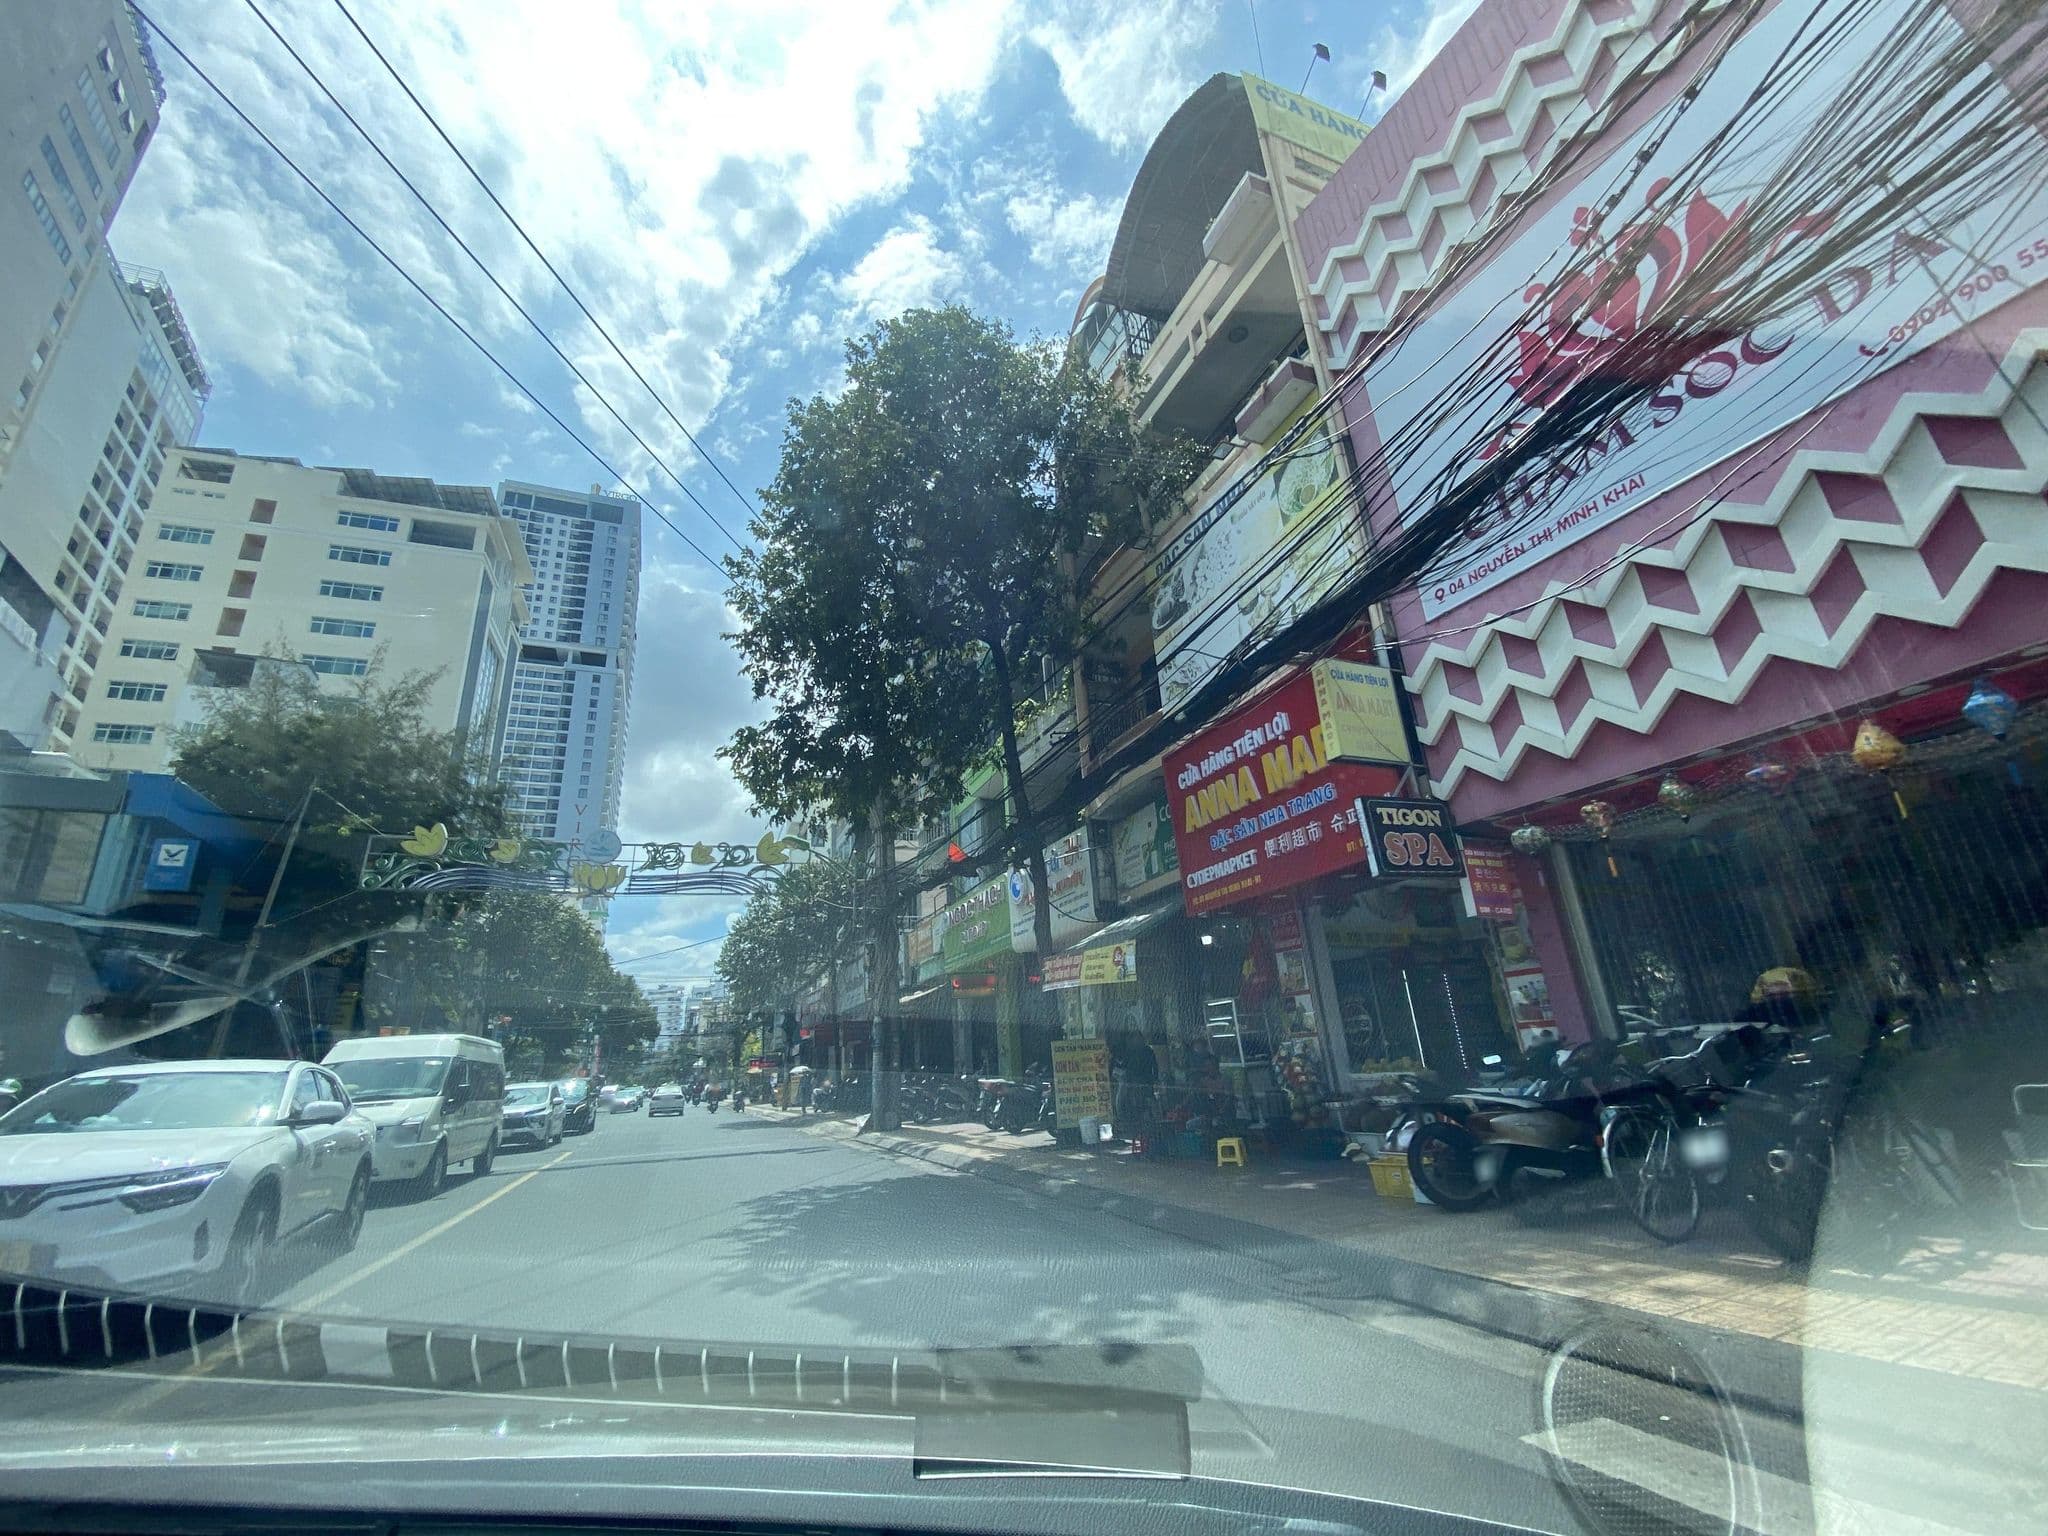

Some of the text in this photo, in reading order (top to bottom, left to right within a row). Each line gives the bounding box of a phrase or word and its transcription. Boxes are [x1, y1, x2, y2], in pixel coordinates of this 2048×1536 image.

[1957, 264, 2010, 301] 900
[1449, 473, 1646, 595] 04 NGUYỄN THỊ MINH KHAI
[1178, 711, 1291, 790] CỬA HÀNG TIỆN LỢI
[1185, 765, 1262, 833] ANNA
[1210, 783, 1337, 853] ĐẶC SẢN NHA TRANG
[1376, 807, 1443, 828] TIGON
[1264, 821, 1322, 858] 便利超市
[1384, 831, 1454, 866] SPA
[1187, 849, 1259, 888] СУПЕРМАРКЕТ
